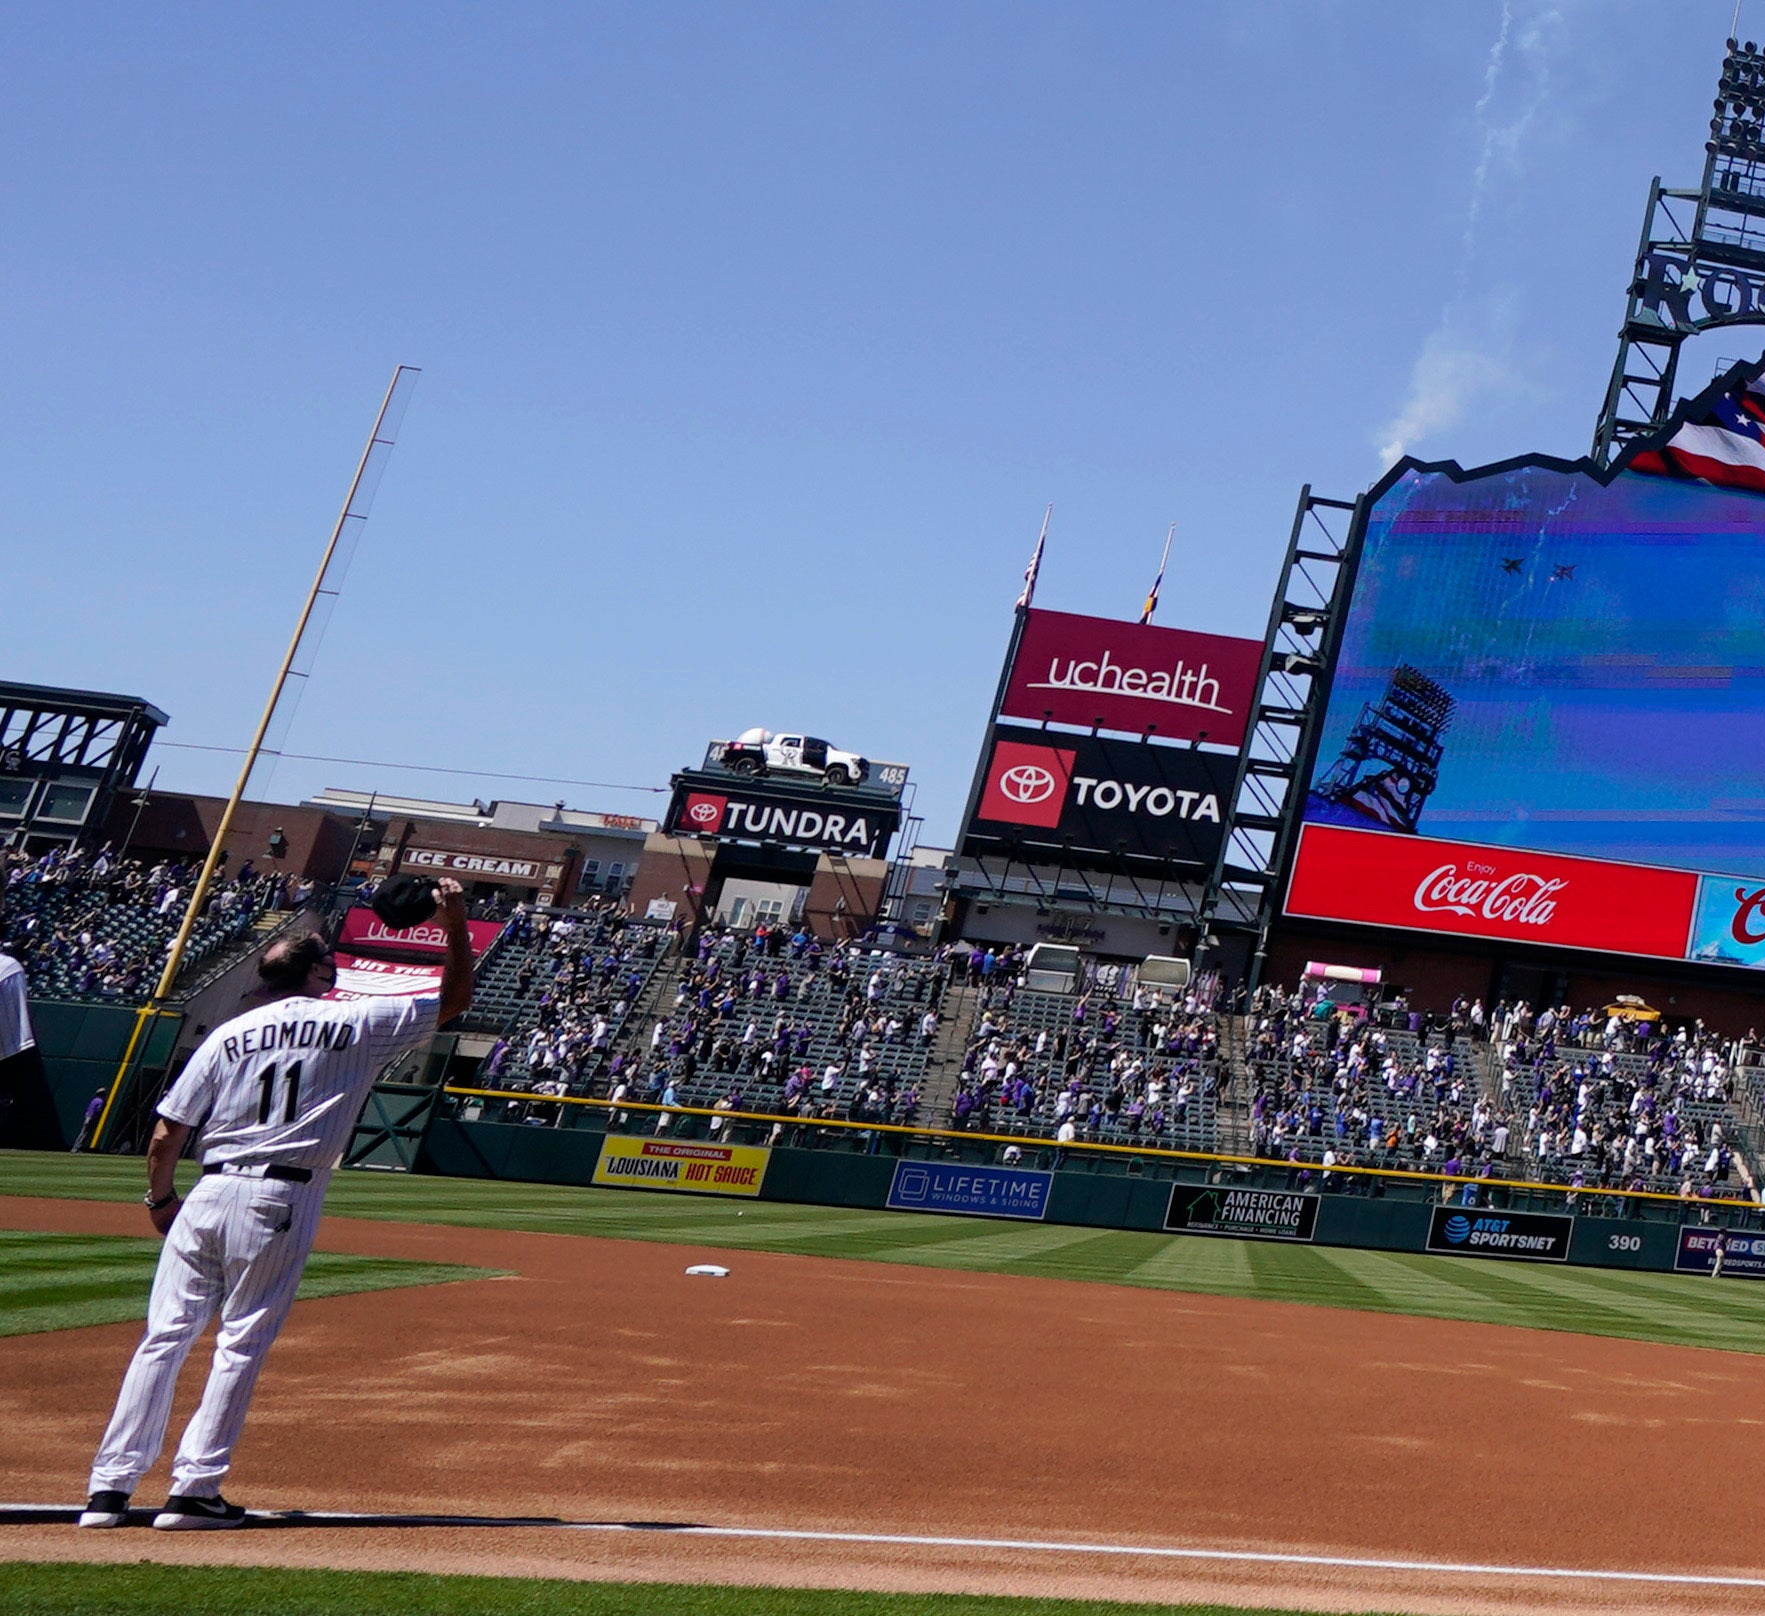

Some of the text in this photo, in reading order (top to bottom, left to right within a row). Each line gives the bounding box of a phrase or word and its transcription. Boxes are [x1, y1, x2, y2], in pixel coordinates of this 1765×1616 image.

[1048, 650, 1220, 707] uchealth
[878, 766, 905, 784] 485
[1073, 776, 1220, 823] TOYOTA
[725, 802, 869, 845] TUNDRA
[408, 851, 532, 876] ICE CREAM
[1466, 861, 1497, 875] Enjoy
[394, 966, 437, 975] THE
[224, 1020, 354, 1062] REDMOND
[258, 1059, 303, 1125] 11
[648, 1145, 727, 1160] THE ORIGINAL
[685, 1163, 716, 1182] HOT
[713, 1165, 759, 1185] SAUCE
[933, 1175, 1043, 1200] LIFETIME
[931, 1192, 1040, 1209] WINDOWS & SIDING
[1225, 1191, 1304, 1212] AMERICAN
[1221, 1206, 1301, 1227] FINANCING
[1473, 1218, 1511, 1233] AT&T
[1469, 1232, 1556, 1251] SPORTSNET
[1608, 1235, 1641, 1251] 390
